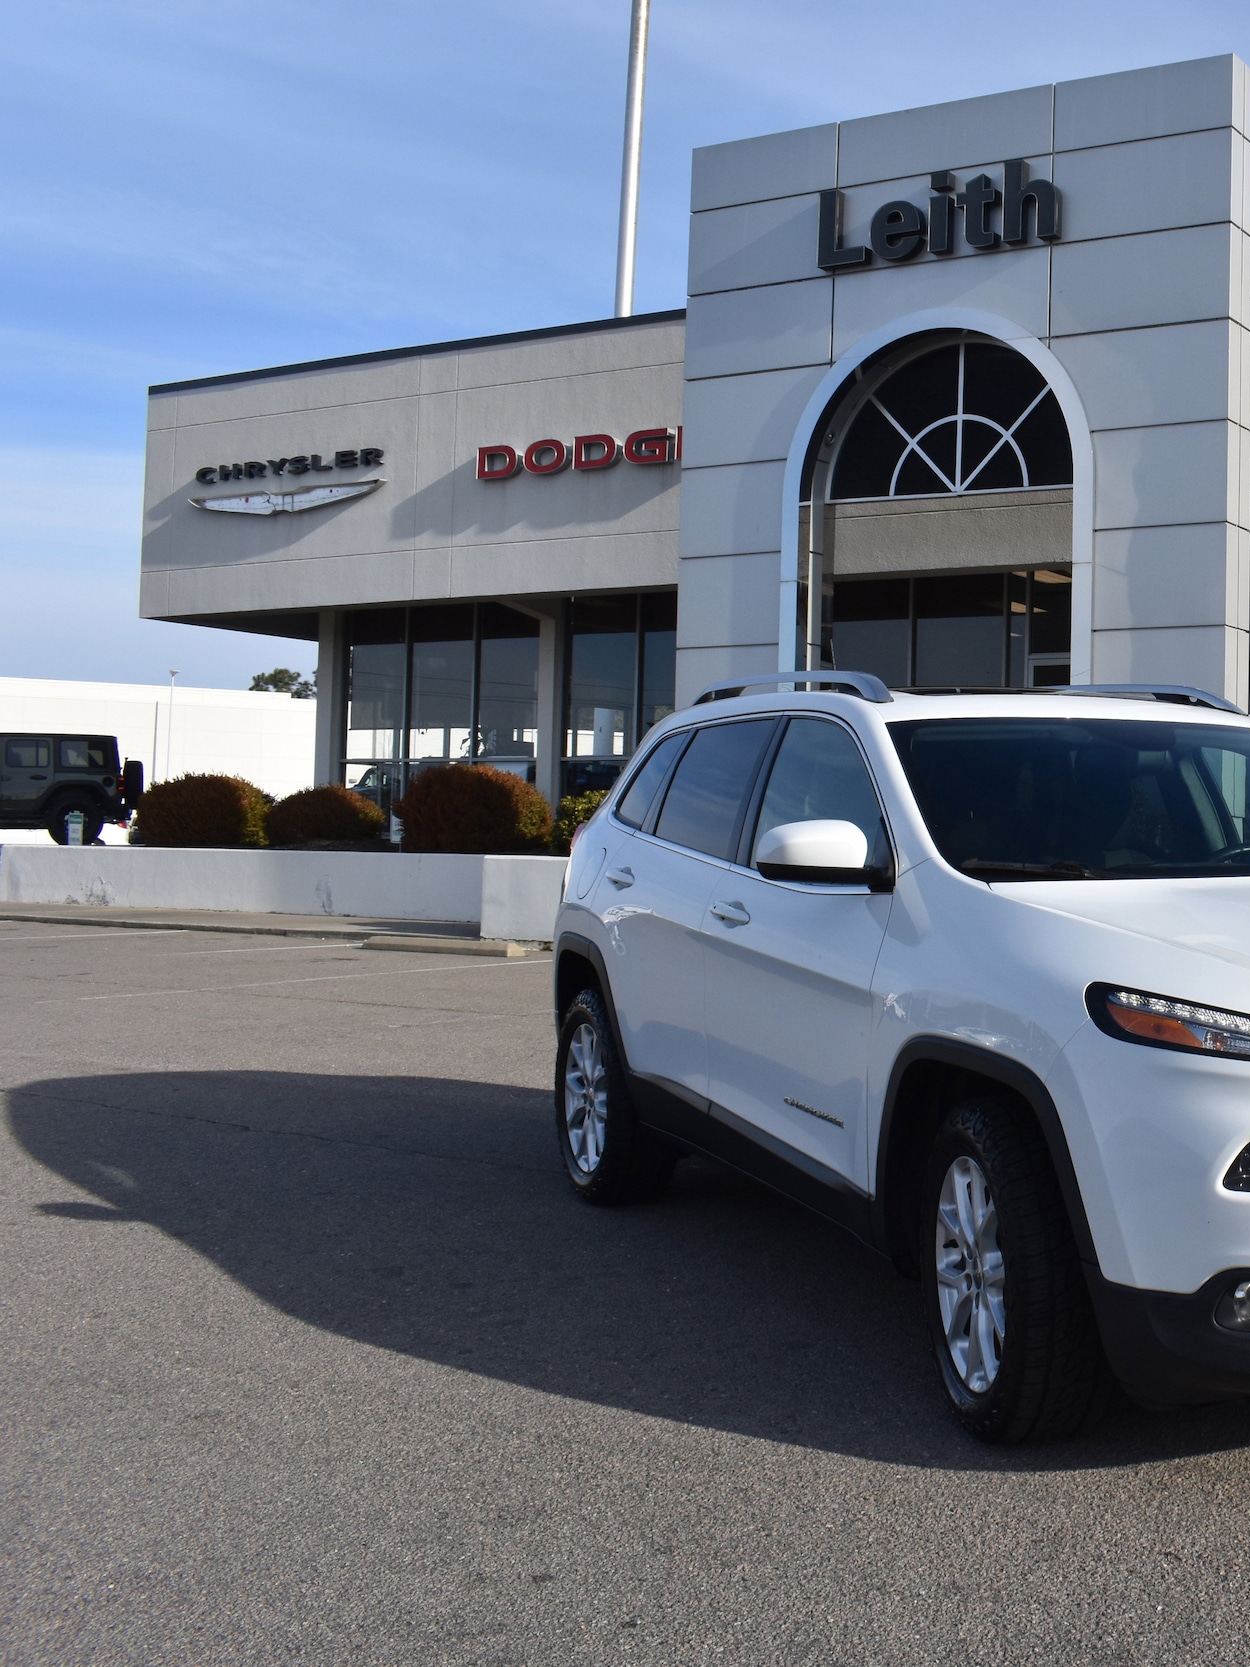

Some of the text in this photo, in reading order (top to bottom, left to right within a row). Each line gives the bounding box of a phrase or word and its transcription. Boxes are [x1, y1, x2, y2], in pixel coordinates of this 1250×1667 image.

[818, 159, 1062, 272] Leith
[196, 448, 384, 484] CHRYSLER
[476, 425, 683, 481] DODG
